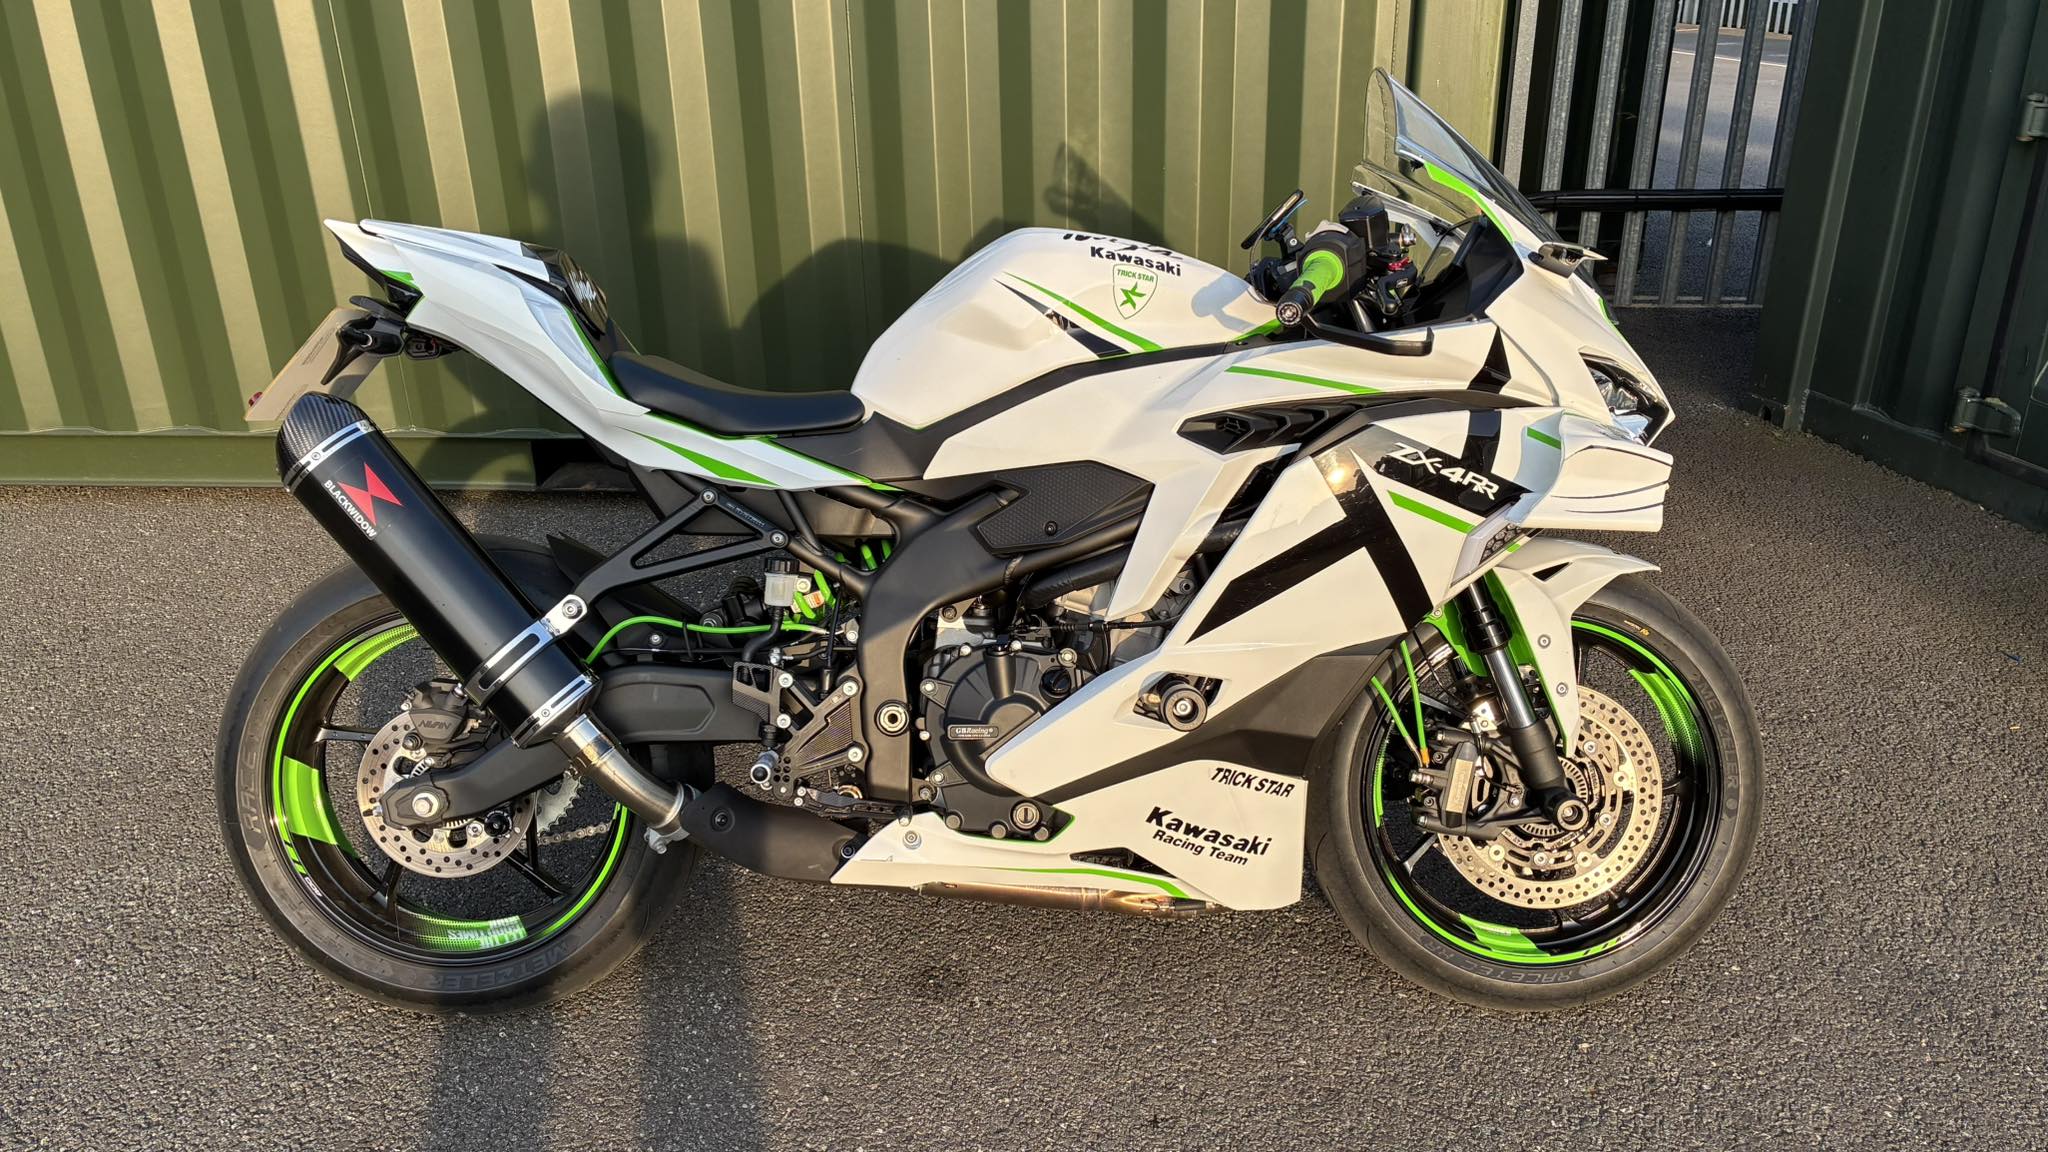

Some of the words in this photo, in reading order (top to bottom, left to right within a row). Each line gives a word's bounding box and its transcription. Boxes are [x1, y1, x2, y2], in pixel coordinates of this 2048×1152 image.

[1090, 246, 1181, 277] Kawasaki
[1117, 269, 1137, 280] TRICK
[1138, 273, 1154, 282] STAR
[1386, 442, 1499, 500] ZX-4RR
[324, 479, 377, 538] BLACKWIDOW
[1211, 767, 1257, 789] TRICK
[1254, 778, 1296, 798] STAR
[1146, 806, 1272, 856] Kawasaki
[1152, 829, 1205, 856] Racing
[1209, 846, 1249, 866] Team
